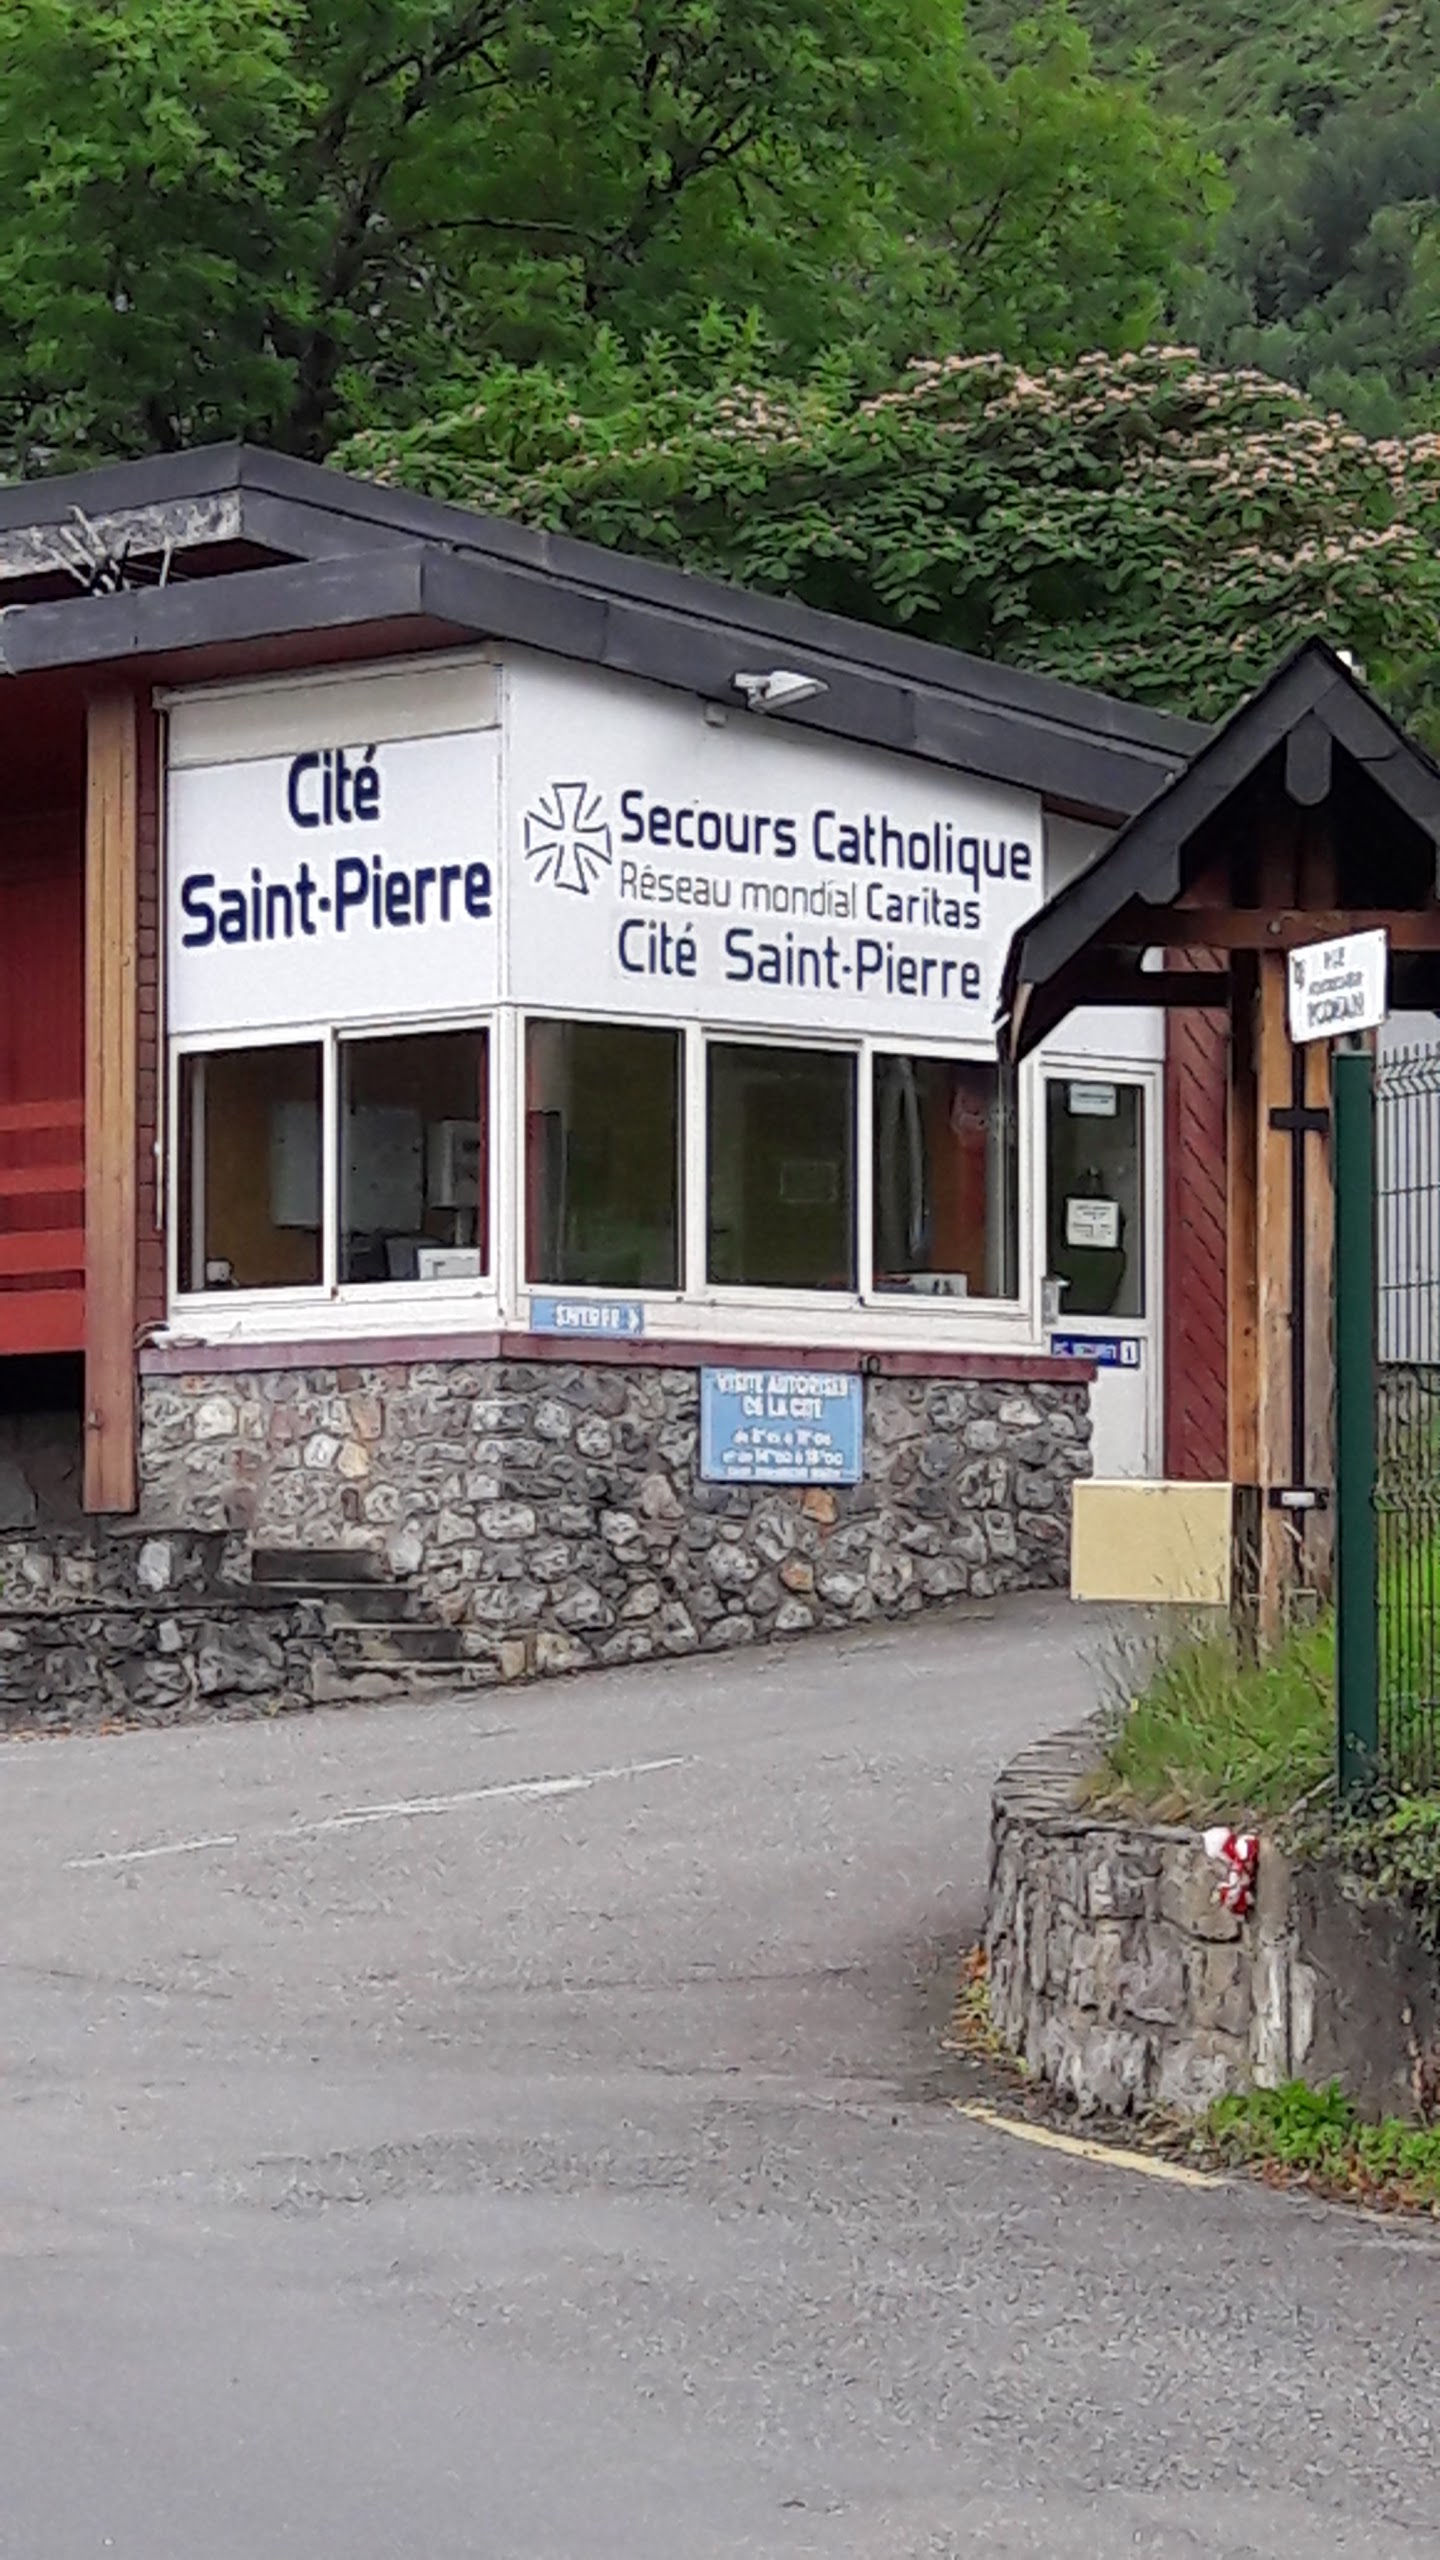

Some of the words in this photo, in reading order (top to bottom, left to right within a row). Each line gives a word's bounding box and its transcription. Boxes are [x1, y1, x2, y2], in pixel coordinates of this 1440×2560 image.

[288, 745, 379, 828] Cité
[621, 790, 796, 858] Secours
[814, 811, 1031, 892] Catholique
[181, 855, 492, 948] Saint-Pierre
[620, 860, 731, 908] Réseau
[741, 878, 856, 919] mondial
[867, 883, 980, 930] Caritas
[618, 919, 697, 977] Cité
[725, 928, 980, 1000] Saint-Pierre
